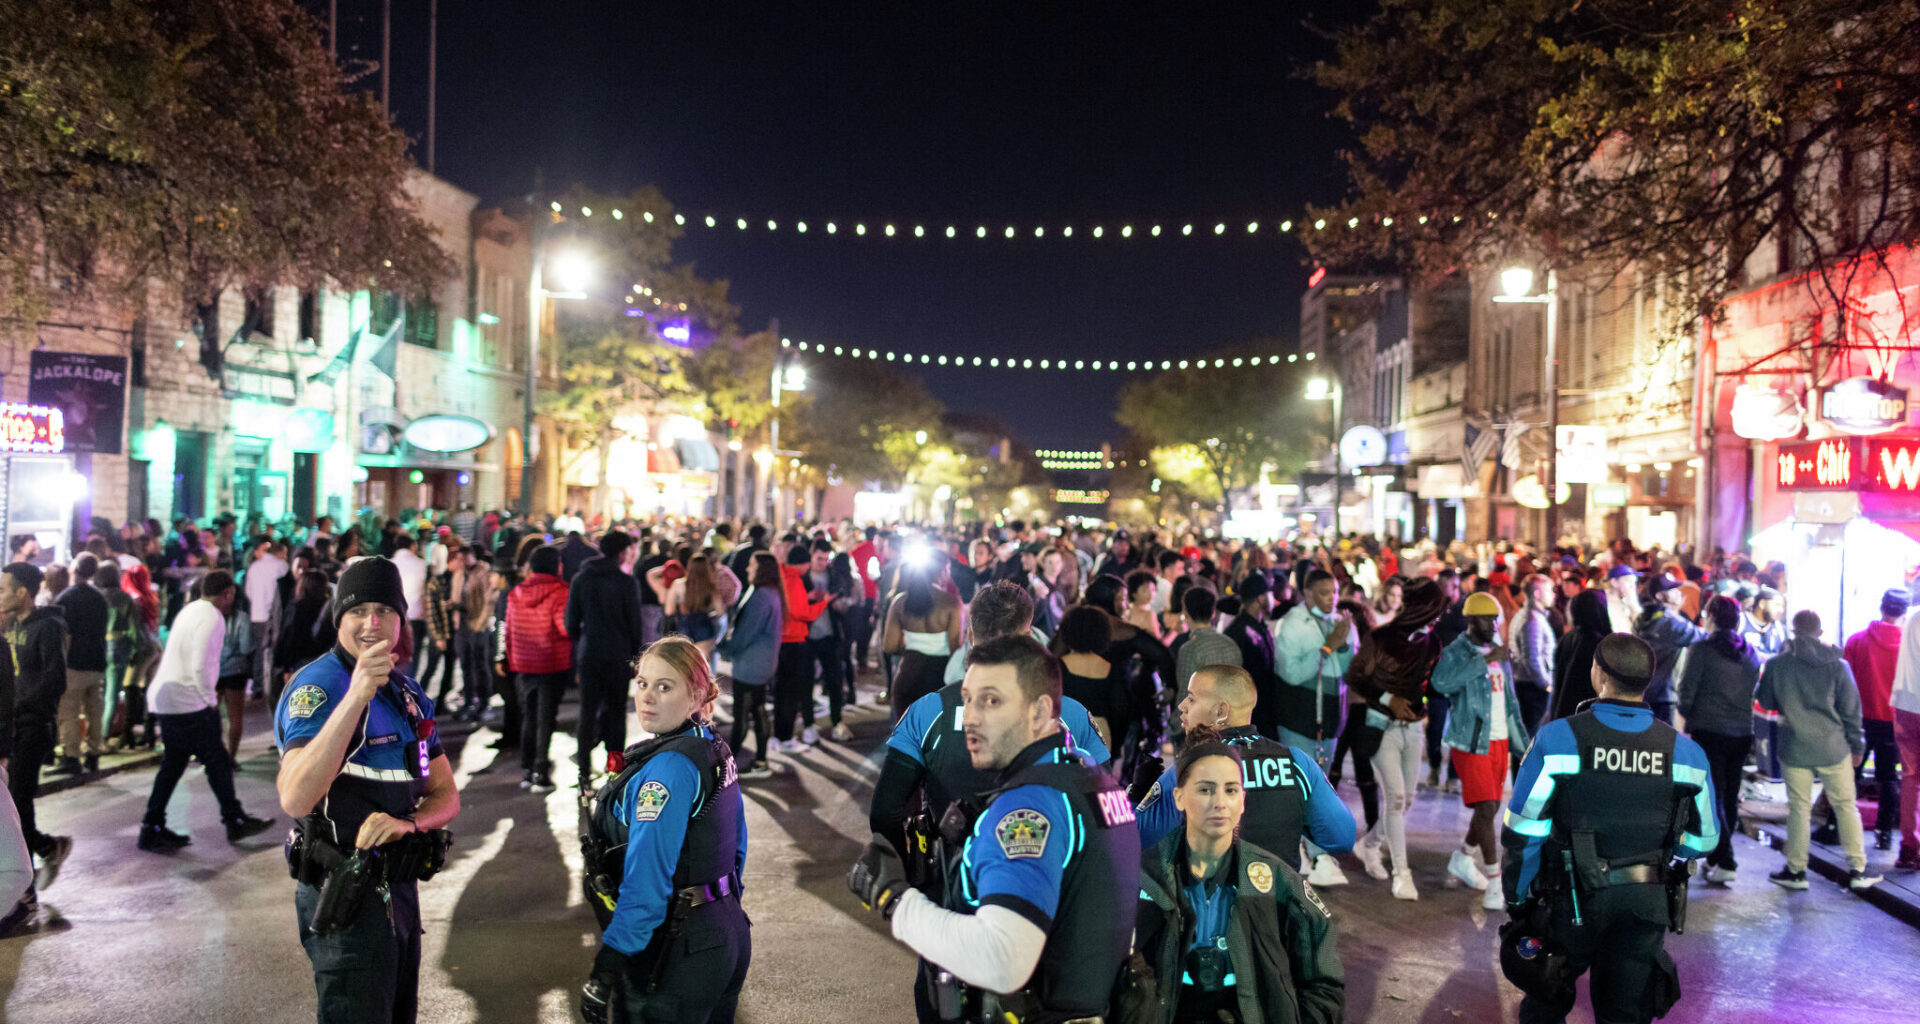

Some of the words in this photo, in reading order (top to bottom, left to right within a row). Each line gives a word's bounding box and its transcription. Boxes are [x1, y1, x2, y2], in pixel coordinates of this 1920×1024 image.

[34, 364, 122, 387] JACKALOPE
[1241, 757, 1295, 789] LICE
[1593, 746, 1664, 775] POLICE
[999, 811, 1045, 831] POLICE
[1097, 789, 1137, 827] POLICE
